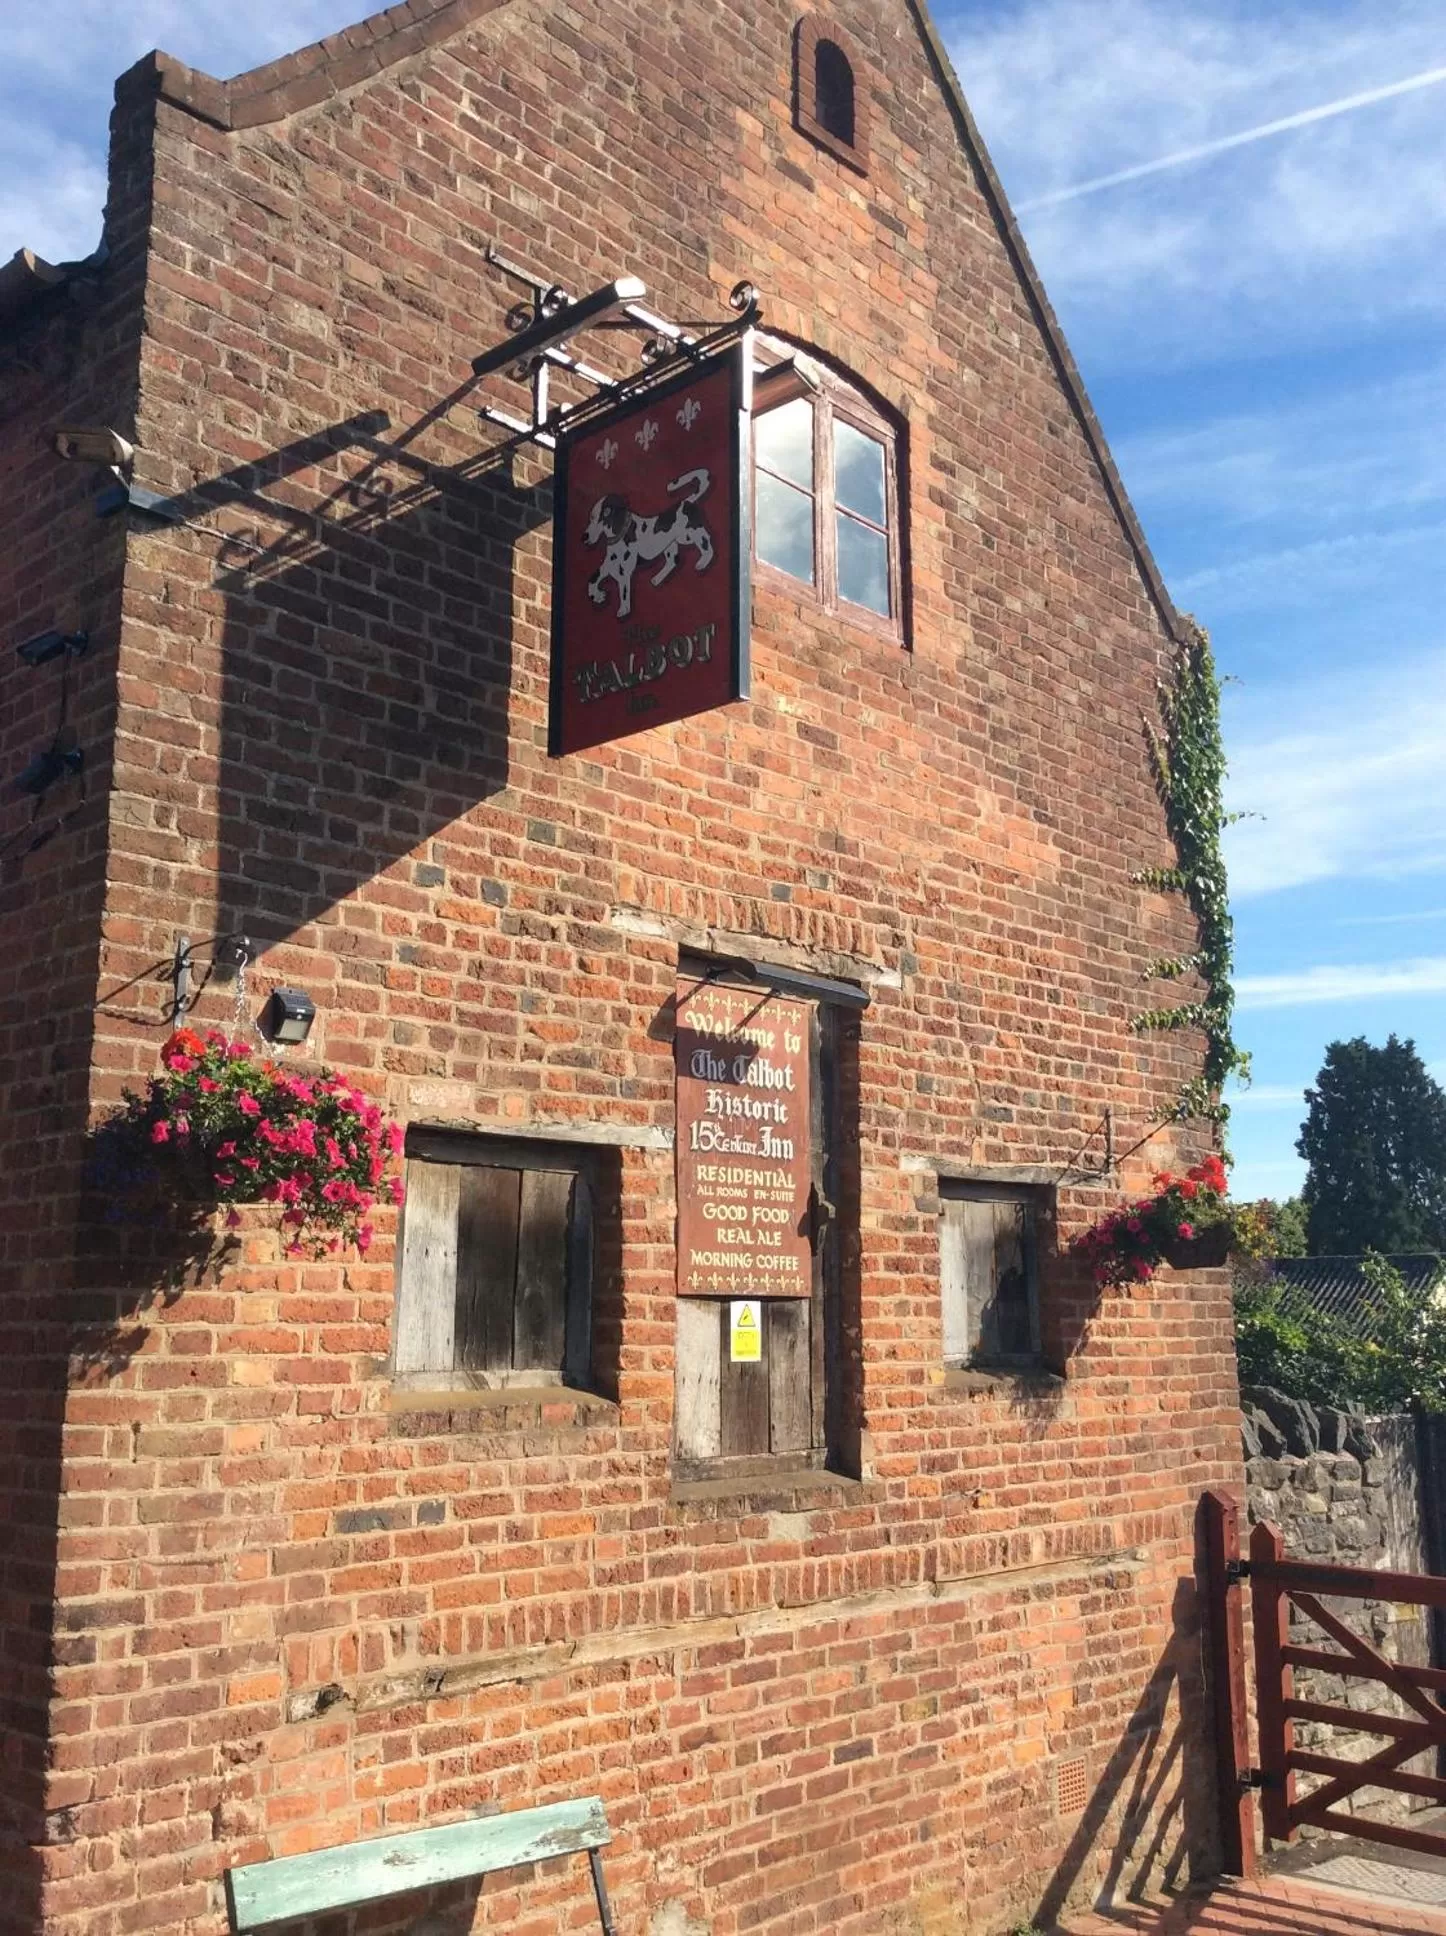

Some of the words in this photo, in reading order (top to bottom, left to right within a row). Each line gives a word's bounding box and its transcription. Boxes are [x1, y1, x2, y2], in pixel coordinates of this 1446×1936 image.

[573, 623, 717, 703] TALBOT
[685, 1011, 775, 1049] Welcome
[784, 1028, 802, 1054] to
[691, 1049, 727, 1080] The
[733, 1054, 796, 1092] Talbot
[704, 1088, 789, 1123] Historic
[758, 1126, 794, 1159] Inn
[697, 1165, 796, 1189] RESIDENTIAL
[697, 1184, 714, 1196] ALL
[716, 1187, 748, 1198] ROOMS
[754, 1189, 795, 1203] EN-SUITE
[703, 1202, 748, 1220] GOOD
[752, 1206, 790, 1227] FOOD
[717, 1228, 754, 1245] REAL
[756, 1229, 782, 1246] ALE
[690, 1249, 753, 1268] MORNING
[756, 1254, 800, 1271] COFFEE
